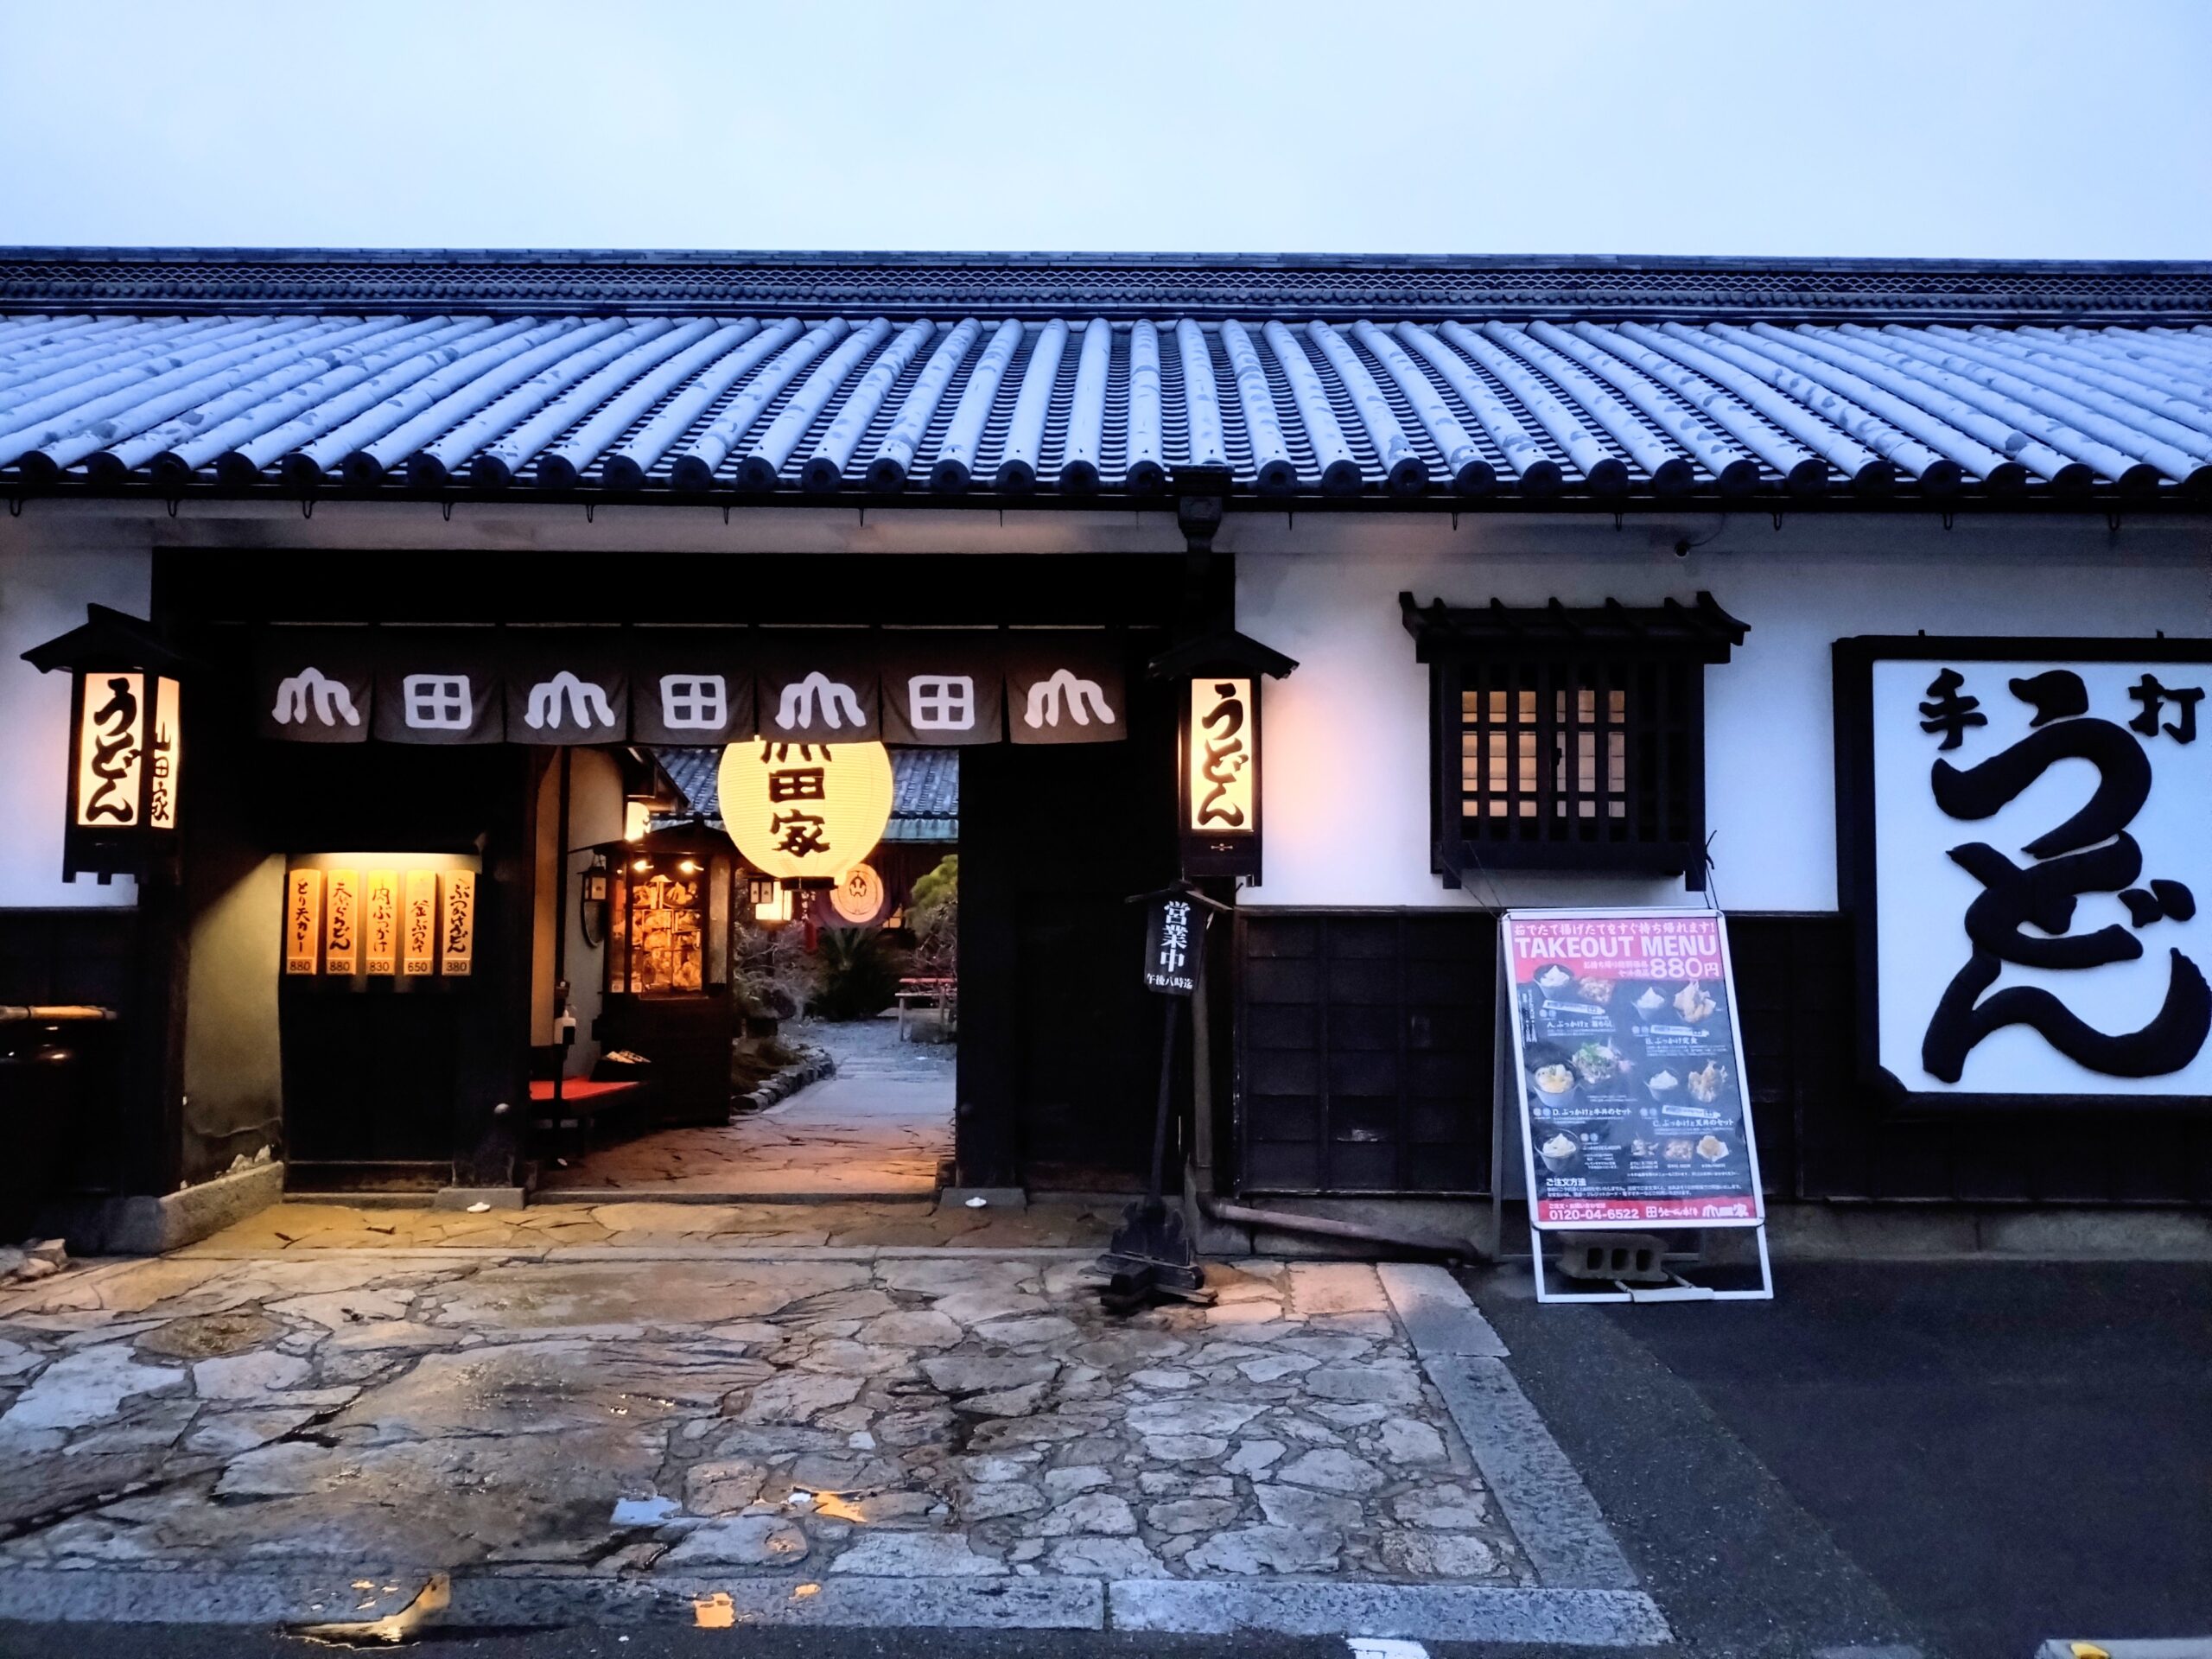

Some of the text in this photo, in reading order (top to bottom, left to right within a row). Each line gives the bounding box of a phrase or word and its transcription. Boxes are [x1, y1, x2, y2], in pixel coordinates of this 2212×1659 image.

[403, 674, 473, 729] 田
[659, 674, 726, 729] 田
[908, 675, 975, 730] 田
[1919, 668, 2205, 751] 手 打
[86, 677, 141, 823] うどん
[1197, 683, 1249, 827] うどん
[1923, 670, 2212, 1084] うどん
[296, 879, 310, 952] とり天カレー
[329, 881, 352, 950] 天ぷらうどん
[372, 879, 391, 952] 肉ぶっかけ
[447, 882, 470, 953] ぶっかけうどん
[1160, 900, 1191, 972] 営業中
[290, 961, 311, 971] 880
[329, 961, 350, 971] 880
[370, 962, 389, 972] 830
[408, 962, 427, 972] 650
[447, 962, 467, 972] 380
[1515, 935, 1717, 958] TAKEOUT MENU
[1649, 957, 1719, 979] 880円
[1147, 973, 1193, 988] 午後八時迄
[1549, 1208, 1640, 1220] 0120-04-6522
